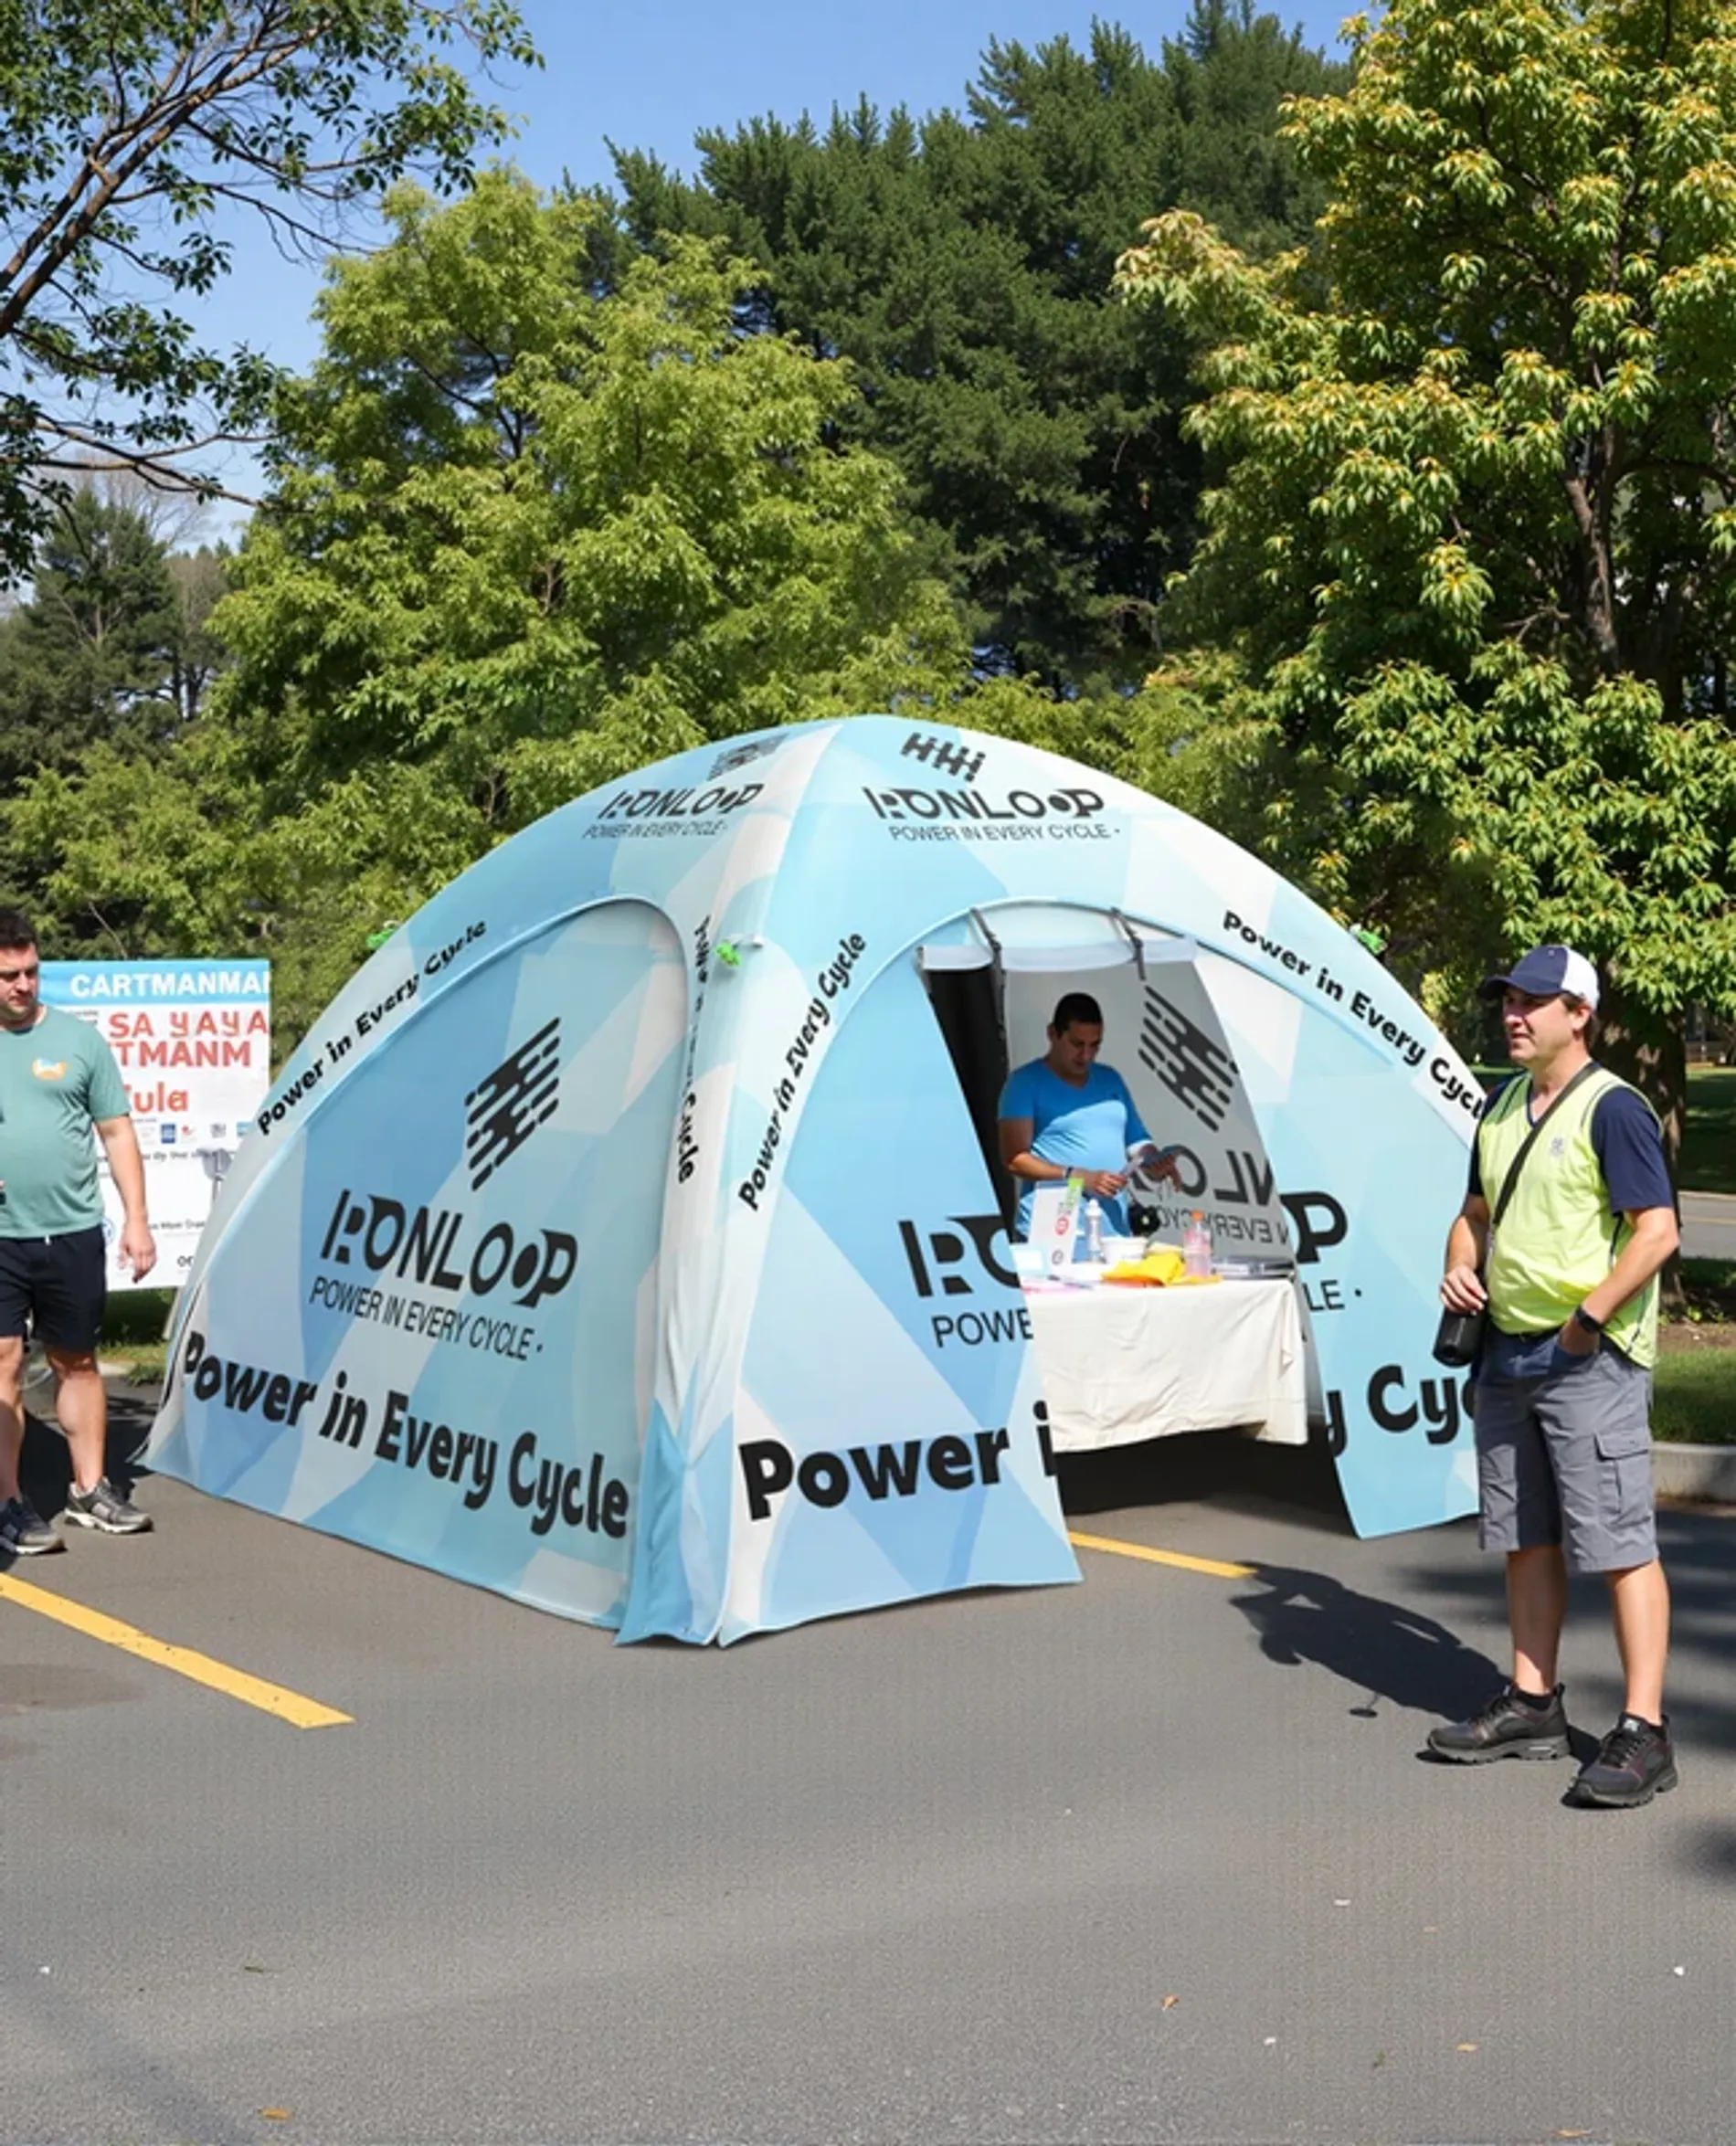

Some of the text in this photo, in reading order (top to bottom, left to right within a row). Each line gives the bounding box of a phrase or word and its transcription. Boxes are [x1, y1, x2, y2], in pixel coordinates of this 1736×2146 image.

[888, 823, 1111, 841] POWER IN EVERY CYCLE
[109, 1011, 154, 1039] SA
[111, 1041, 251, 1068] TMANM
[258, 1059, 323, 1136] Power
[324, 1035, 353, 1063] in
[355, 973, 419, 1037] Every
[1223, 910, 1485, 1120] Power in Every Cycl
[737, 933, 867, 1210] Power in Every Cycle
[309, 1276, 535, 1361] POWER IN EVERY CYCLE
[931, 1308, 1033, 1348] POWE
[185, 1330, 630, 1538] Power in Every Cycle
[738, 1401, 1057, 1521] Power i
